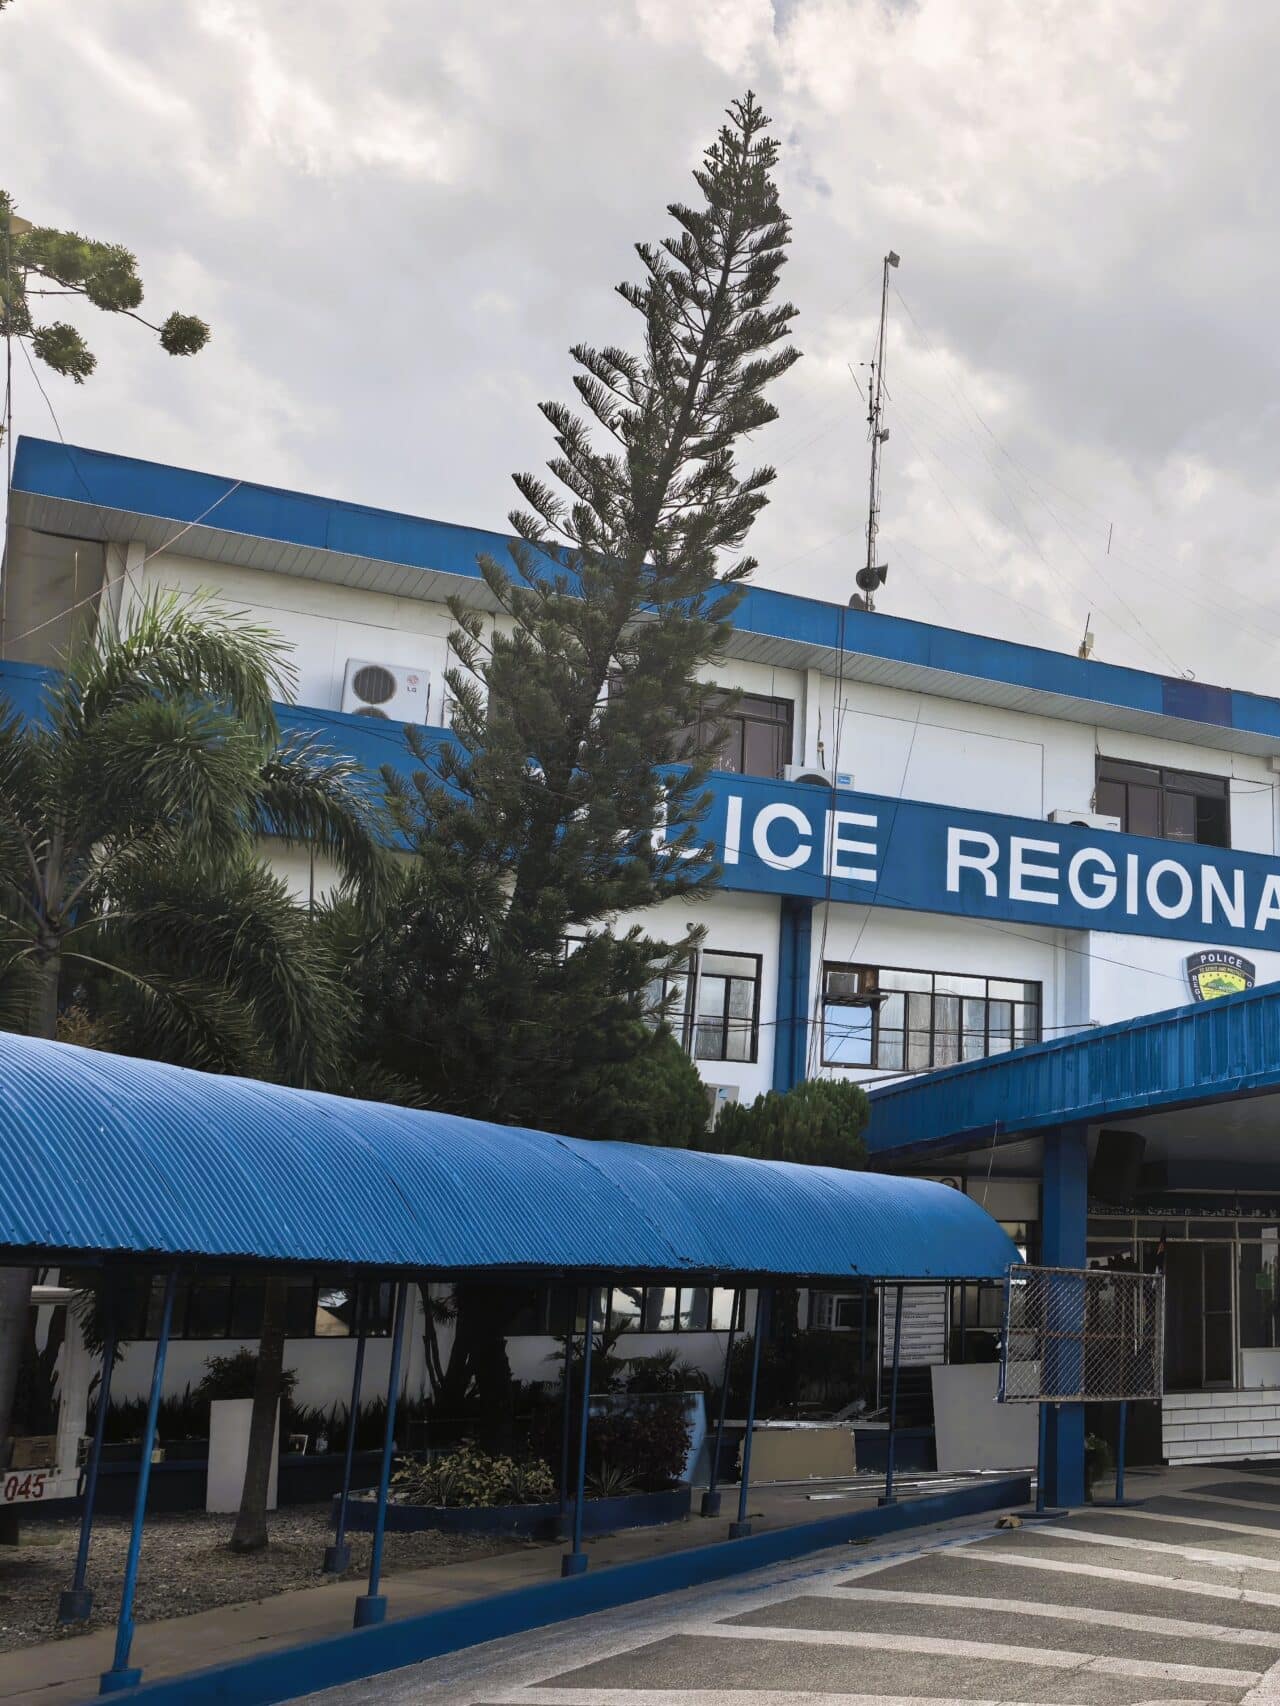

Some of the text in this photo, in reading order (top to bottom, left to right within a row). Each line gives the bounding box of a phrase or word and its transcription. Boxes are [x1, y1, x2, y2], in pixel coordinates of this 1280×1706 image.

[565, 777, 878, 882] LICE
[1200, 953, 1242, 968] POLICE
[5, 1474, 46, 1501] 045
